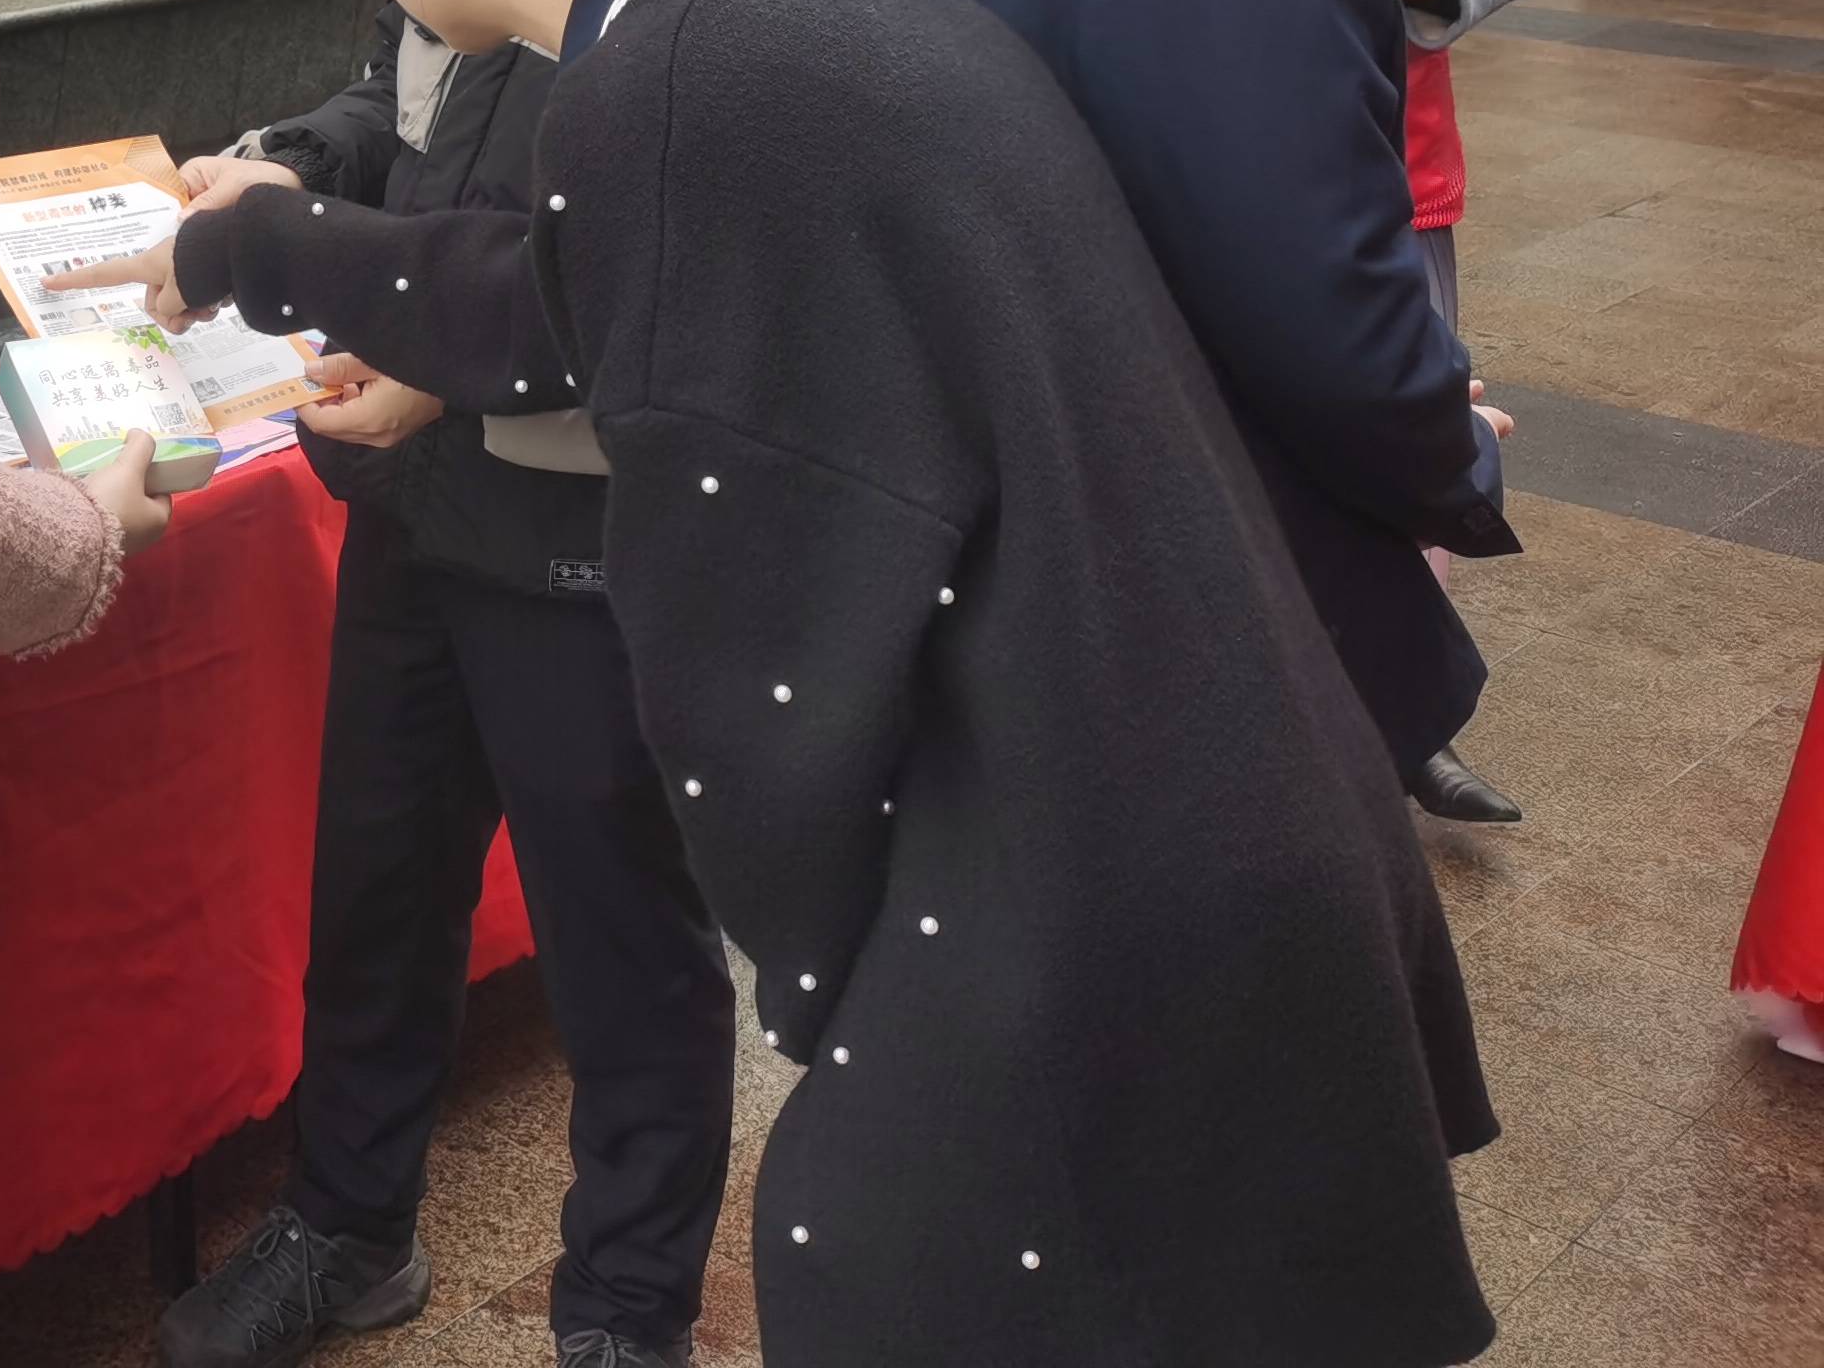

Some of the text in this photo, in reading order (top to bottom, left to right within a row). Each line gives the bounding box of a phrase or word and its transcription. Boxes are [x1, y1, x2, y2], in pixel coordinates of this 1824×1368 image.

[38, 355, 160, 386] 同心远离毒品
[52, 376, 168, 408] 共享美好人生
